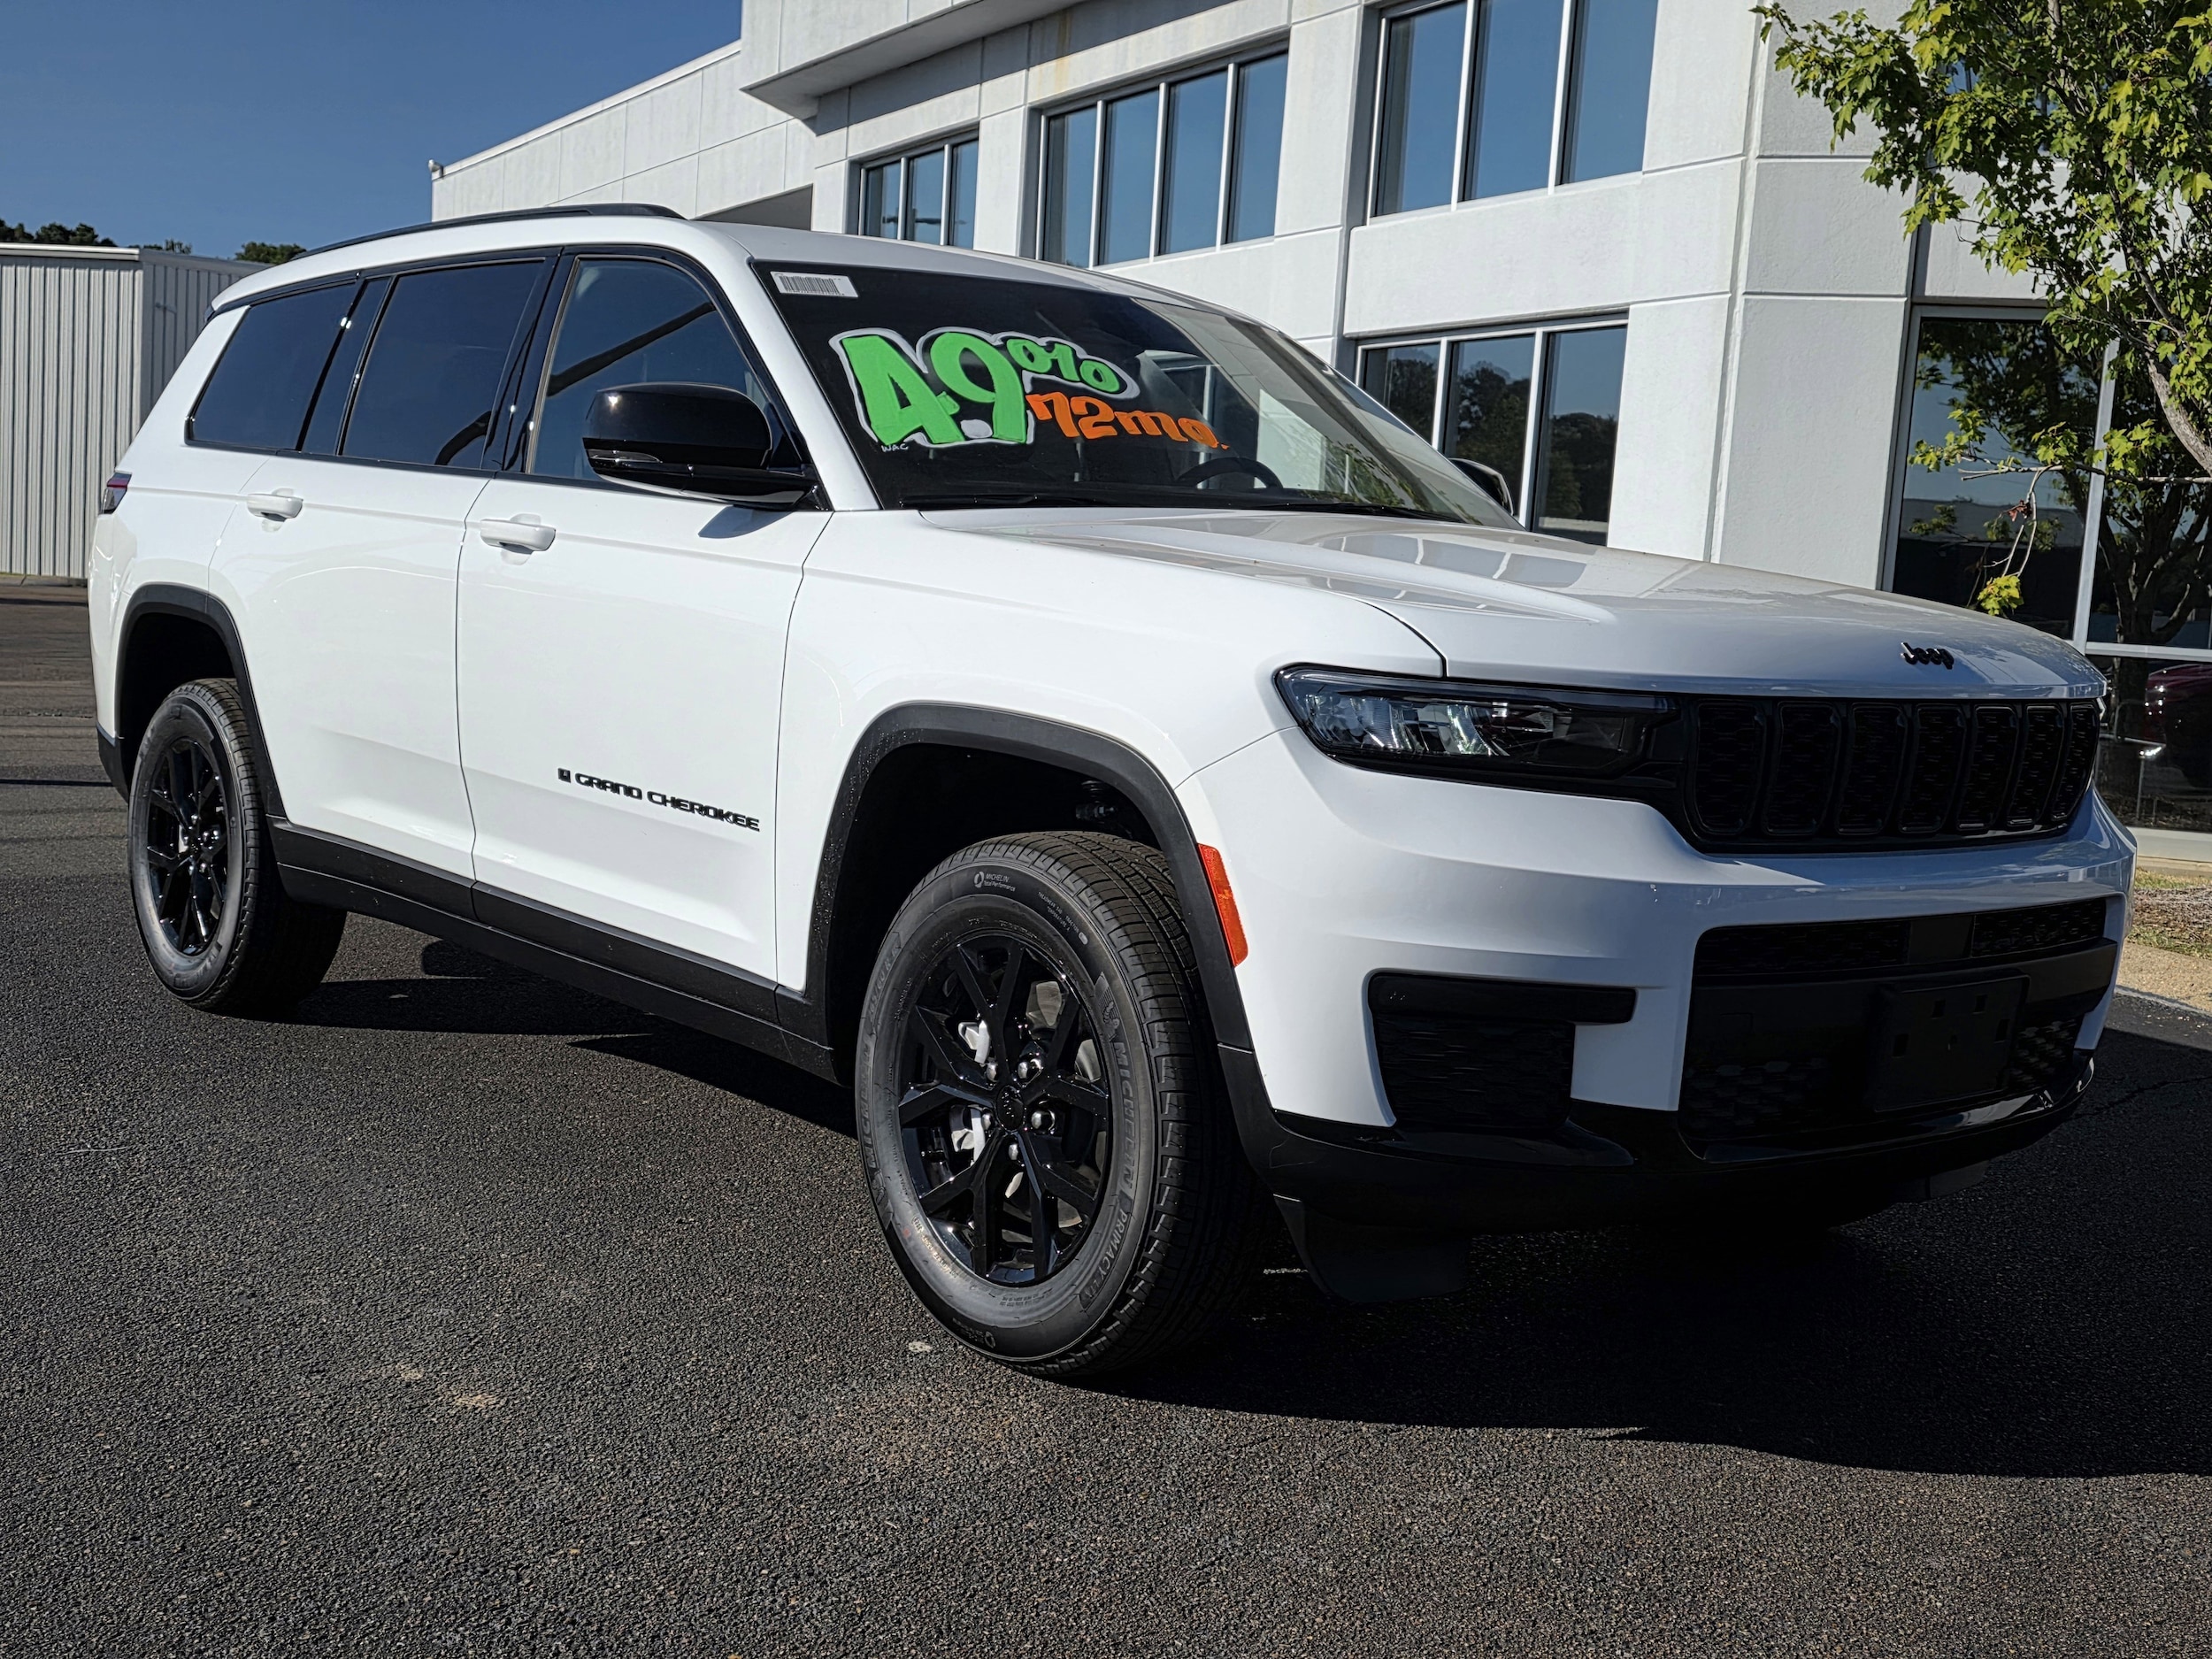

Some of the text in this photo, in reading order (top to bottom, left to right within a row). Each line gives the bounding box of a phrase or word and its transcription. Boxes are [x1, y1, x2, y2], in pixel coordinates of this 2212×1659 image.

[1900, 642, 1955, 670] Jeep
[575, 772, 760, 832] GRAND CHEROKEE
[986, 872, 1010, 883] MICHELIN
[1114, 1041, 1135, 1190] MICHELIN
[1098, 1209, 1128, 1280] PRIMACY
